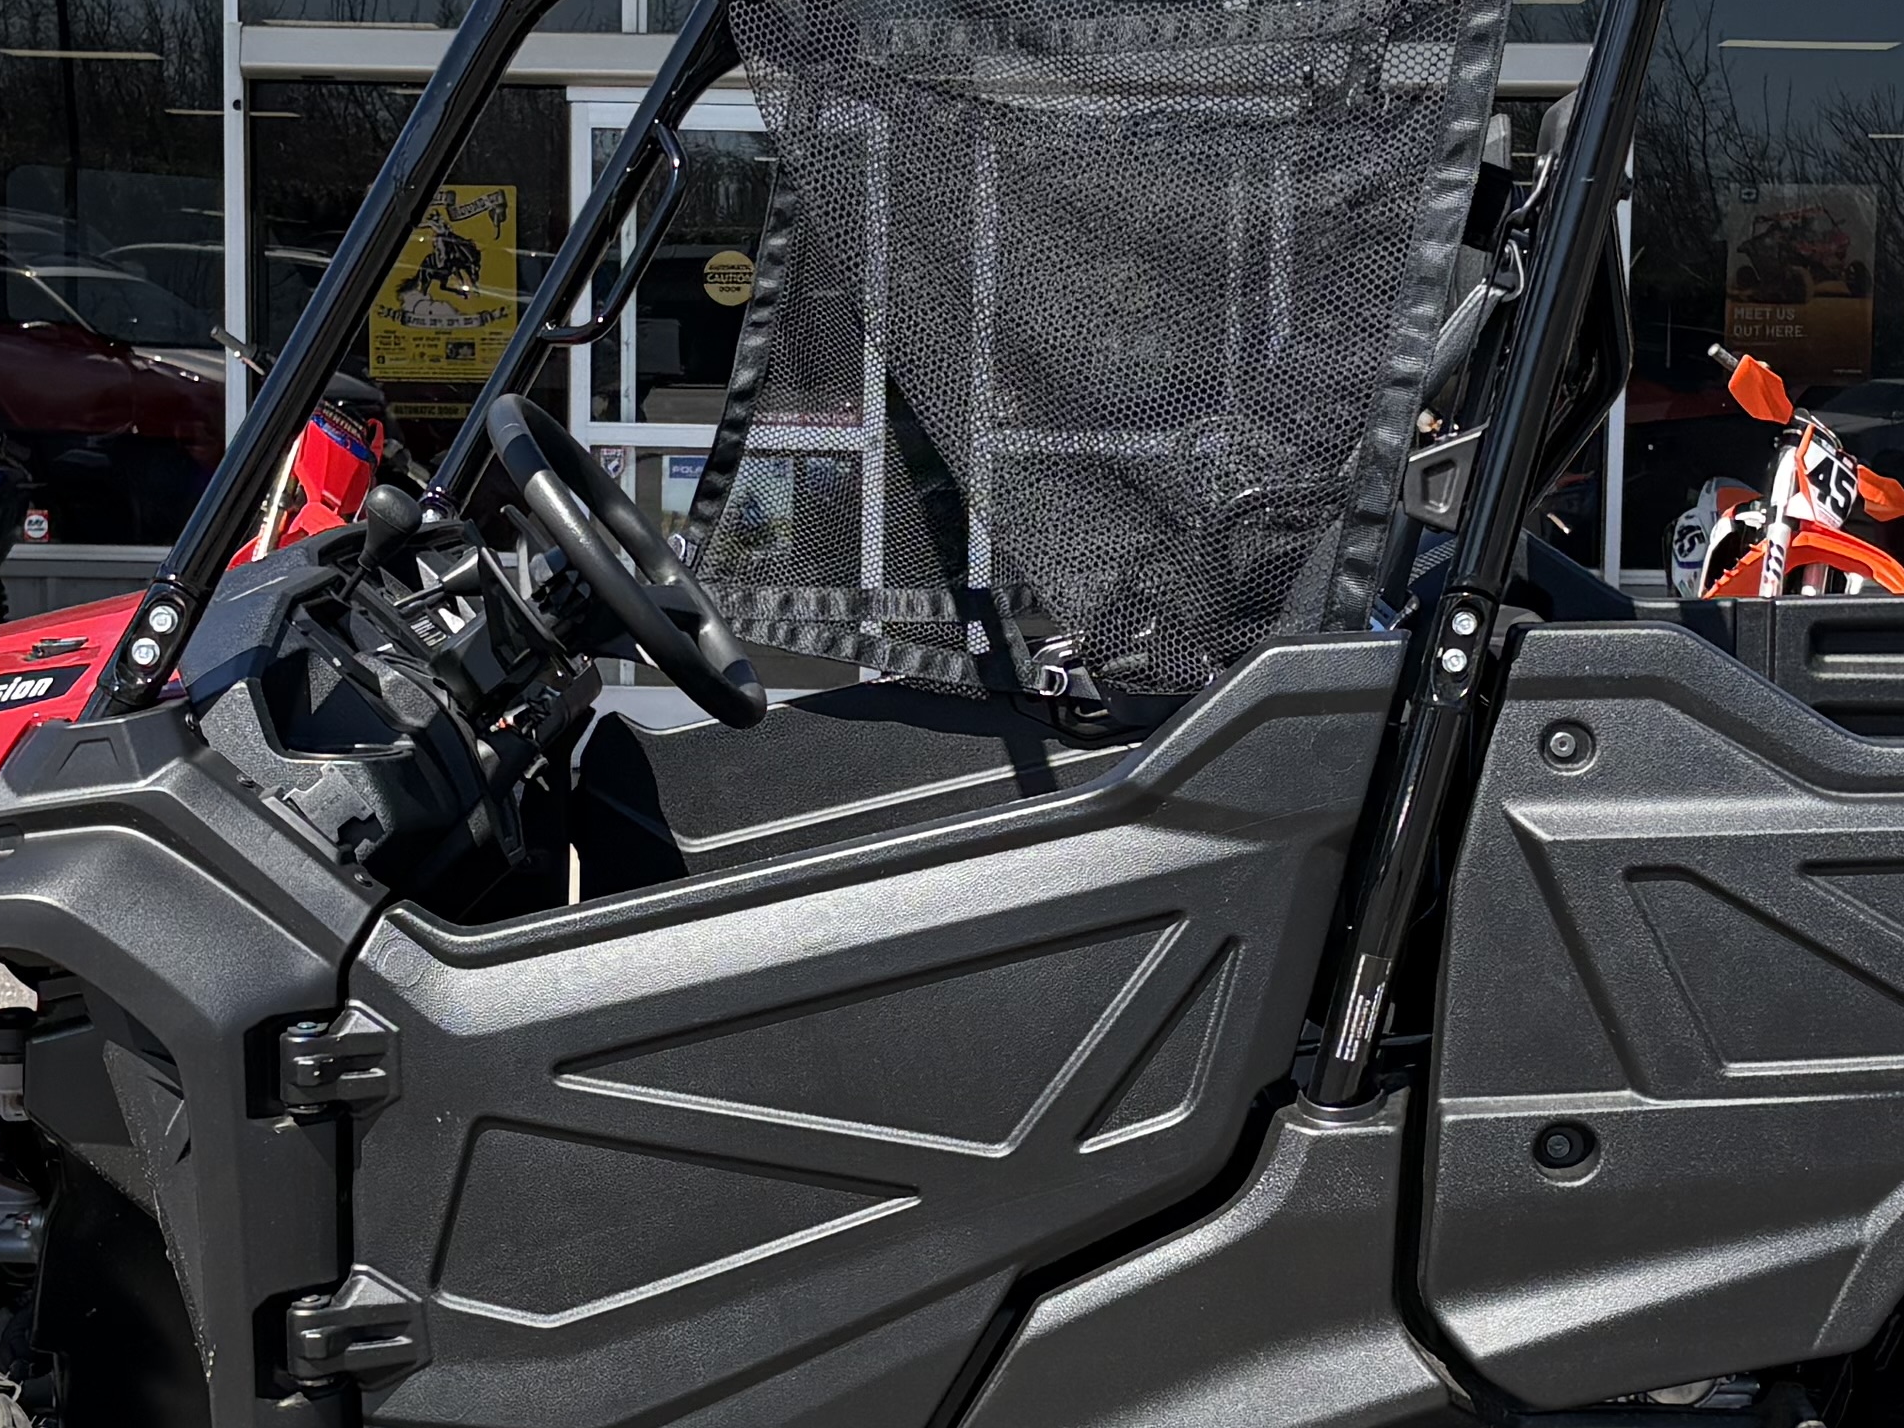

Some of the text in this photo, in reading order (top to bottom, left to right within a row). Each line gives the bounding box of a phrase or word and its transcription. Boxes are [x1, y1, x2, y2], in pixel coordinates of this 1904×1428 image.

[1733, 307, 1797, 321] MEET US
[1733, 324, 1760, 338] OUT
[1807, 456, 1857, 523] 45
